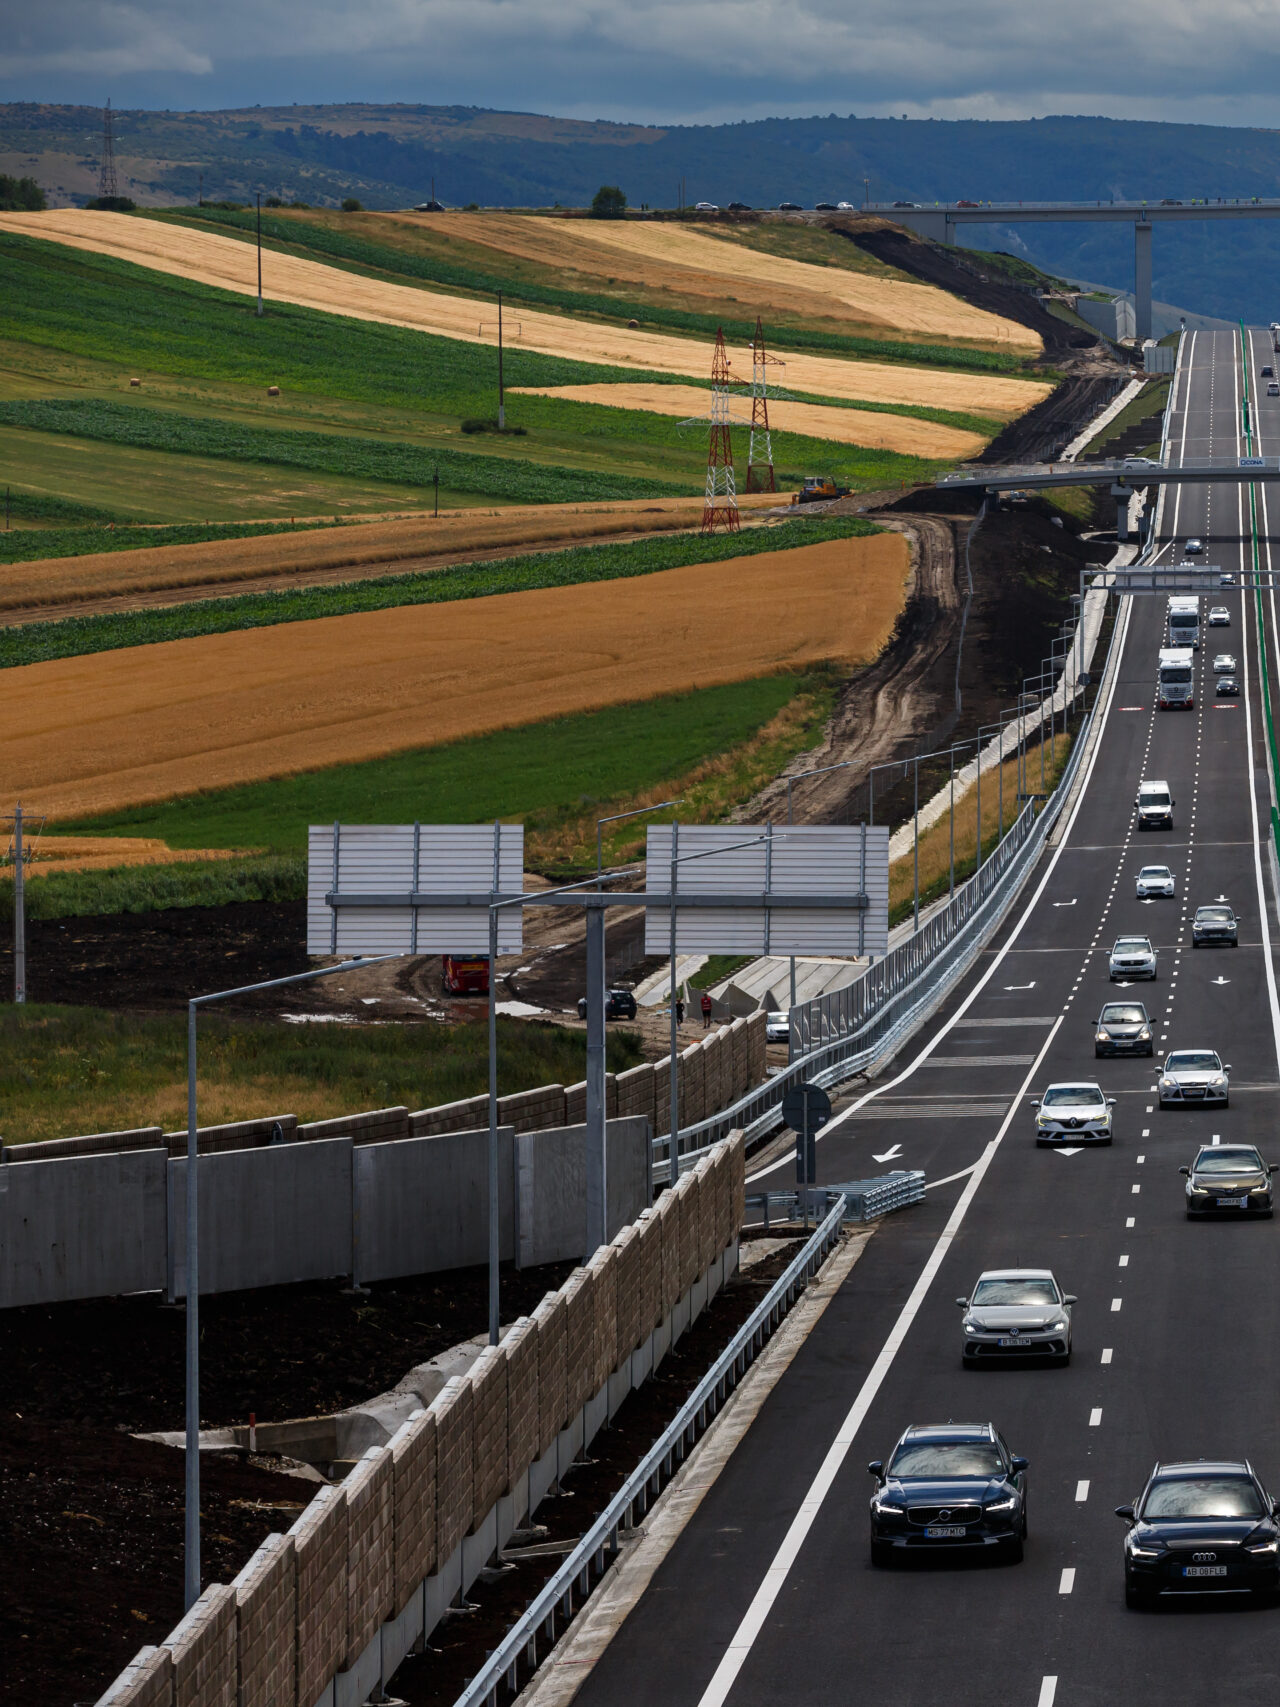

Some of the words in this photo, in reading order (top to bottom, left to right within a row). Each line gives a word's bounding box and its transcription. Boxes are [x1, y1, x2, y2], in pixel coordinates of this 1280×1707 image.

[928, 1528, 939, 1536] MS
[1187, 1567, 1198, 1575] AB
[1209, 1567, 1225, 1575] FLE
